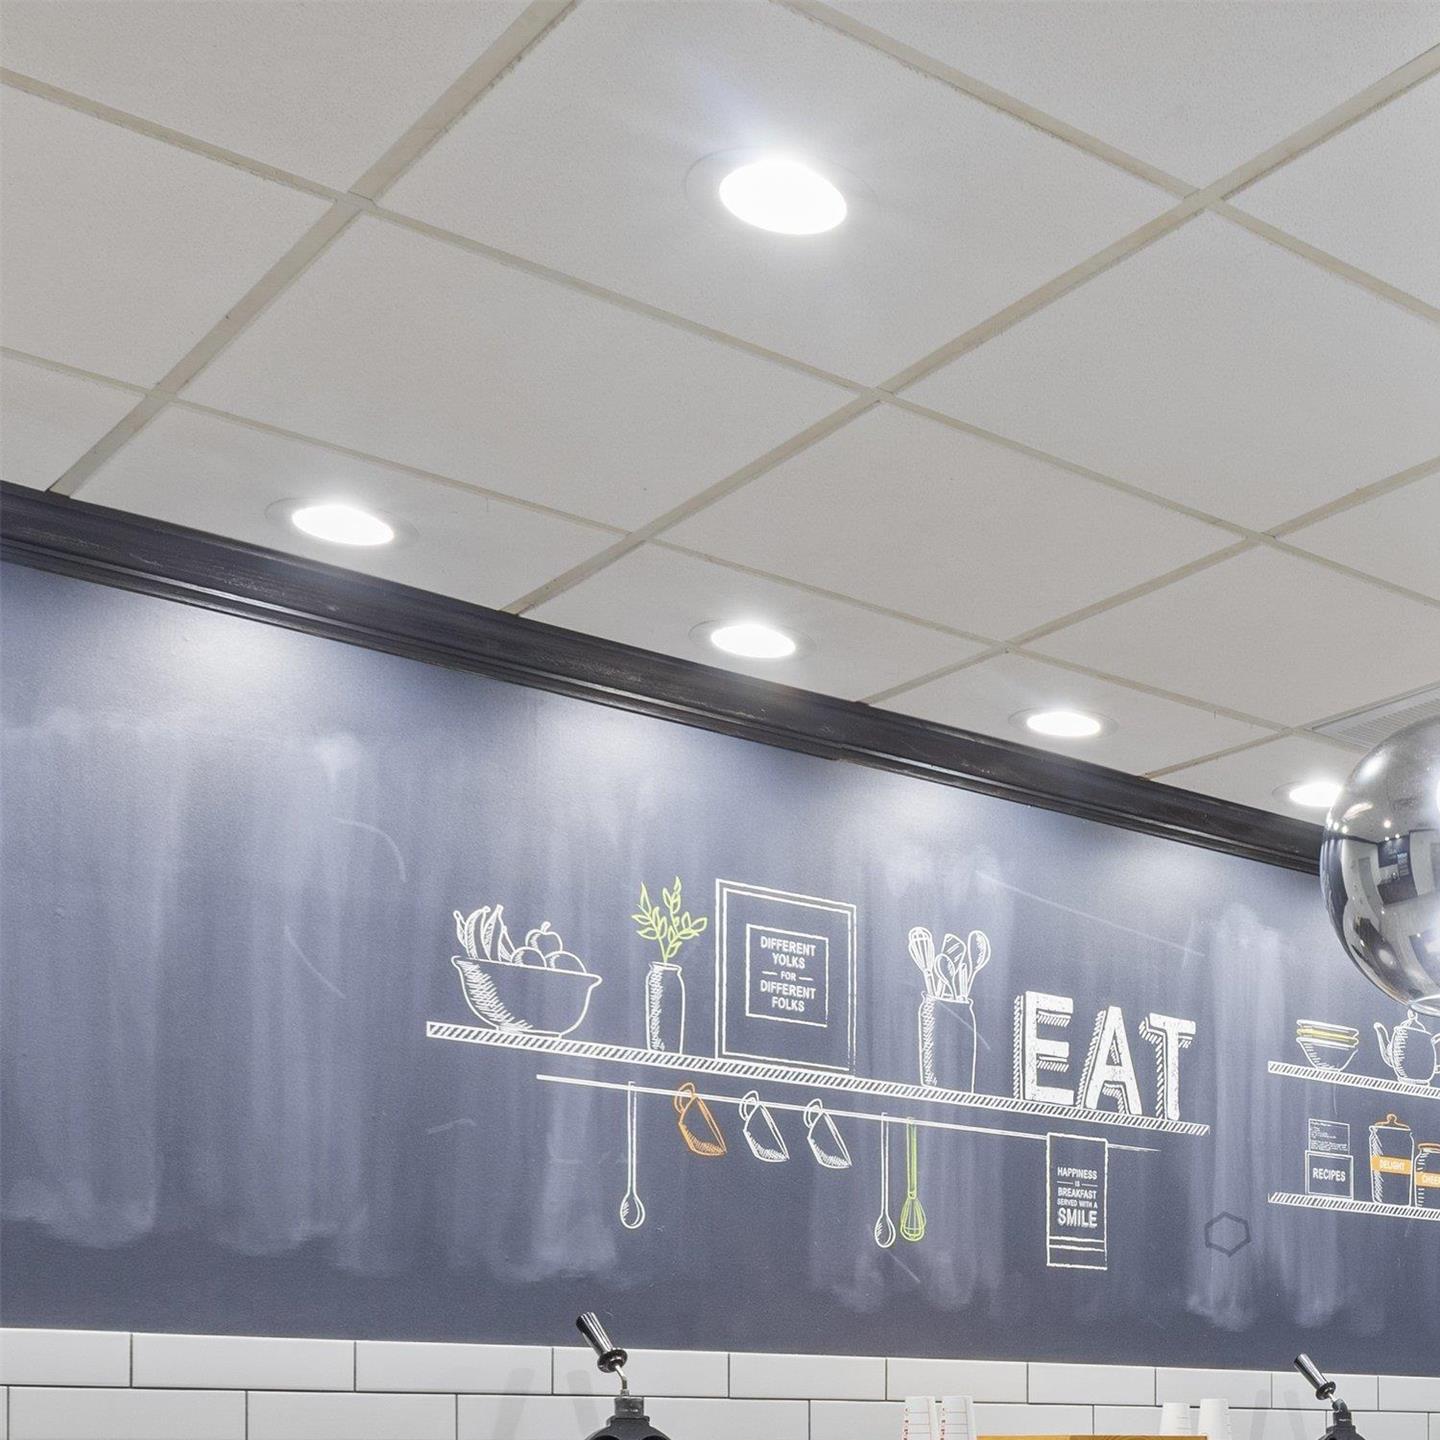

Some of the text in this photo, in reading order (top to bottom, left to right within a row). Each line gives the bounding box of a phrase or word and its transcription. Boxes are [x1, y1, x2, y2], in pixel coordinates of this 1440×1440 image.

[760, 935, 816, 957] DIFFERENT
[772, 952, 806, 970] YOLKS
[780, 970, 797, 982] FOR
[760, 979, 816, 1000] DIFFERENT
[771, 996, 805, 1013] FOLKS
[1013, 990, 1196, 1121] EAT
[1057, 1166, 1098, 1180] HAPPINESS
[1312, 1168, 1346, 1182] RECIPES
[1057, 1187, 1098, 1200] BREAKFAST
[1057, 1198, 1078, 1207] SERVED
[1093, 1201, 1098, 1209] A
[1058, 1207, 1098, 1229] SMILE
